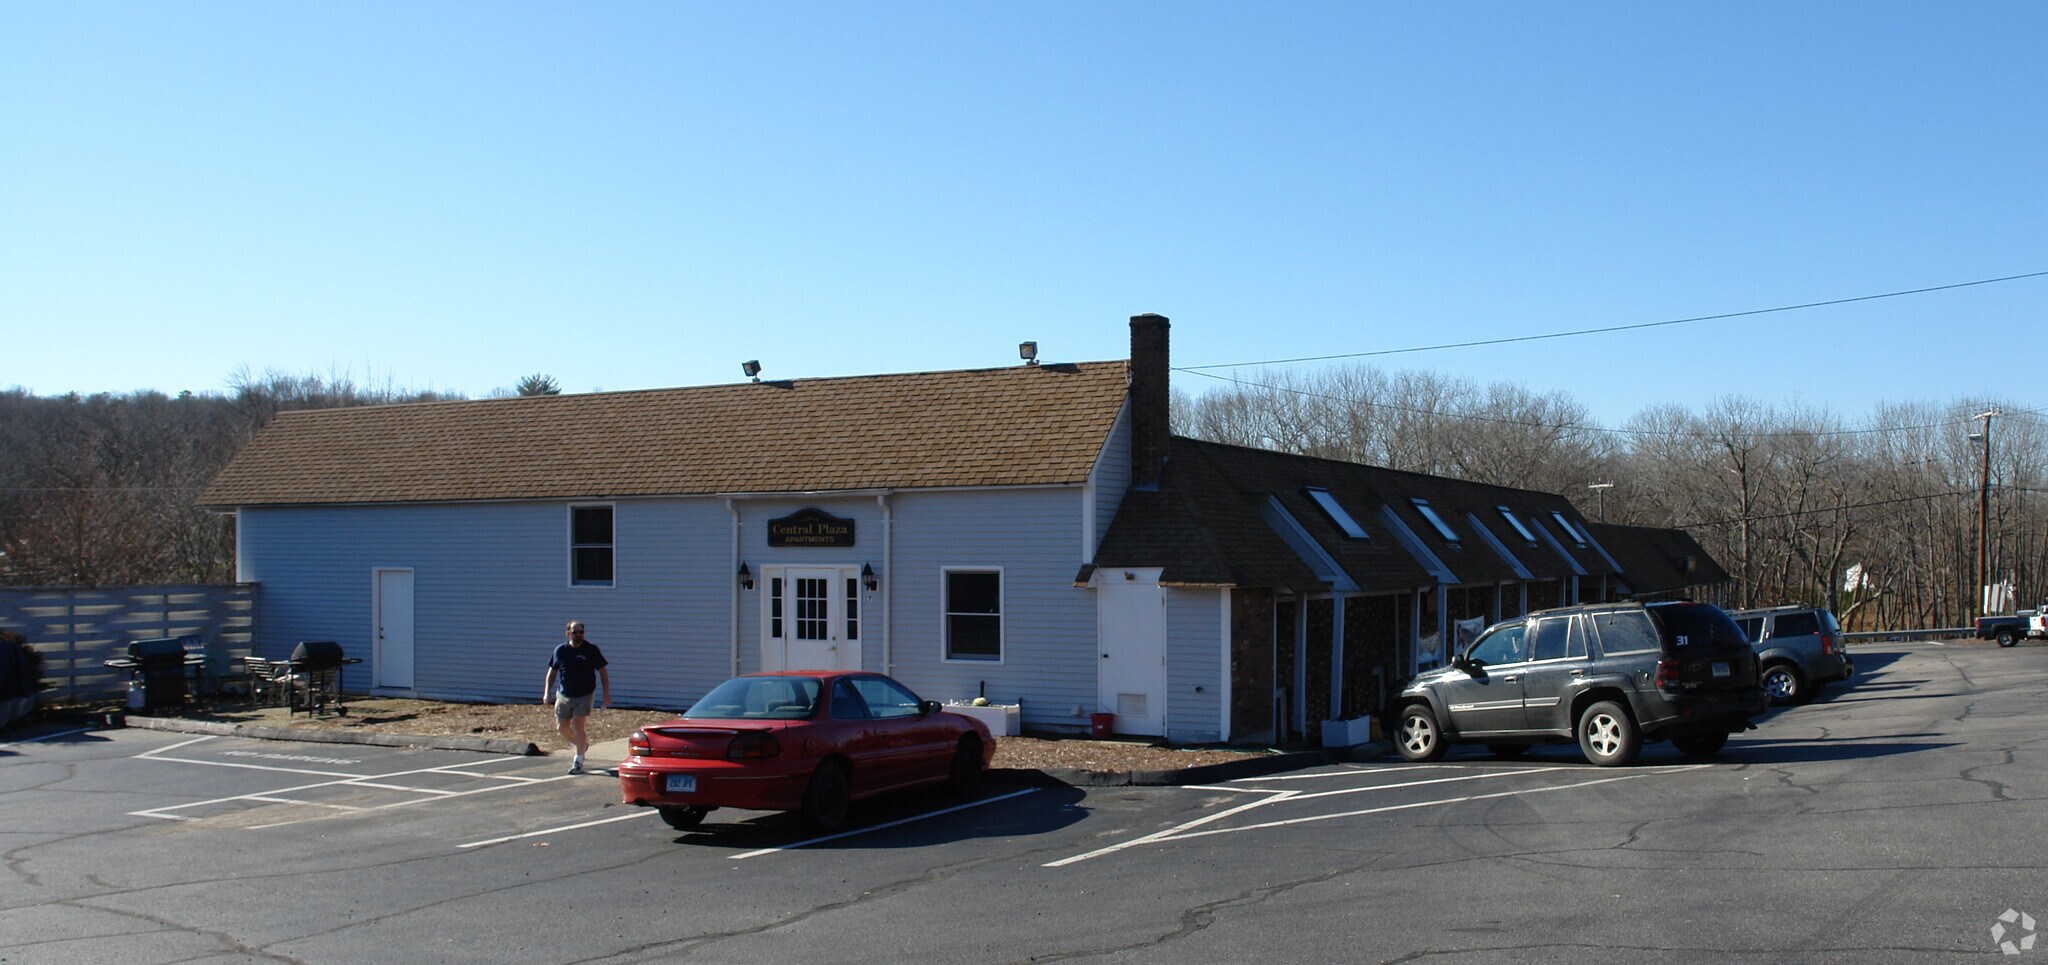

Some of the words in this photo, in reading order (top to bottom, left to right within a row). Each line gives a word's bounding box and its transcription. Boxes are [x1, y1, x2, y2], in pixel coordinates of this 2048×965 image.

[773, 523, 813, 535] Central
[818, 523, 848, 535] Plaza
[785, 535, 835, 543] APARTMENTS
[1675, 635, 1689, 646] 31
